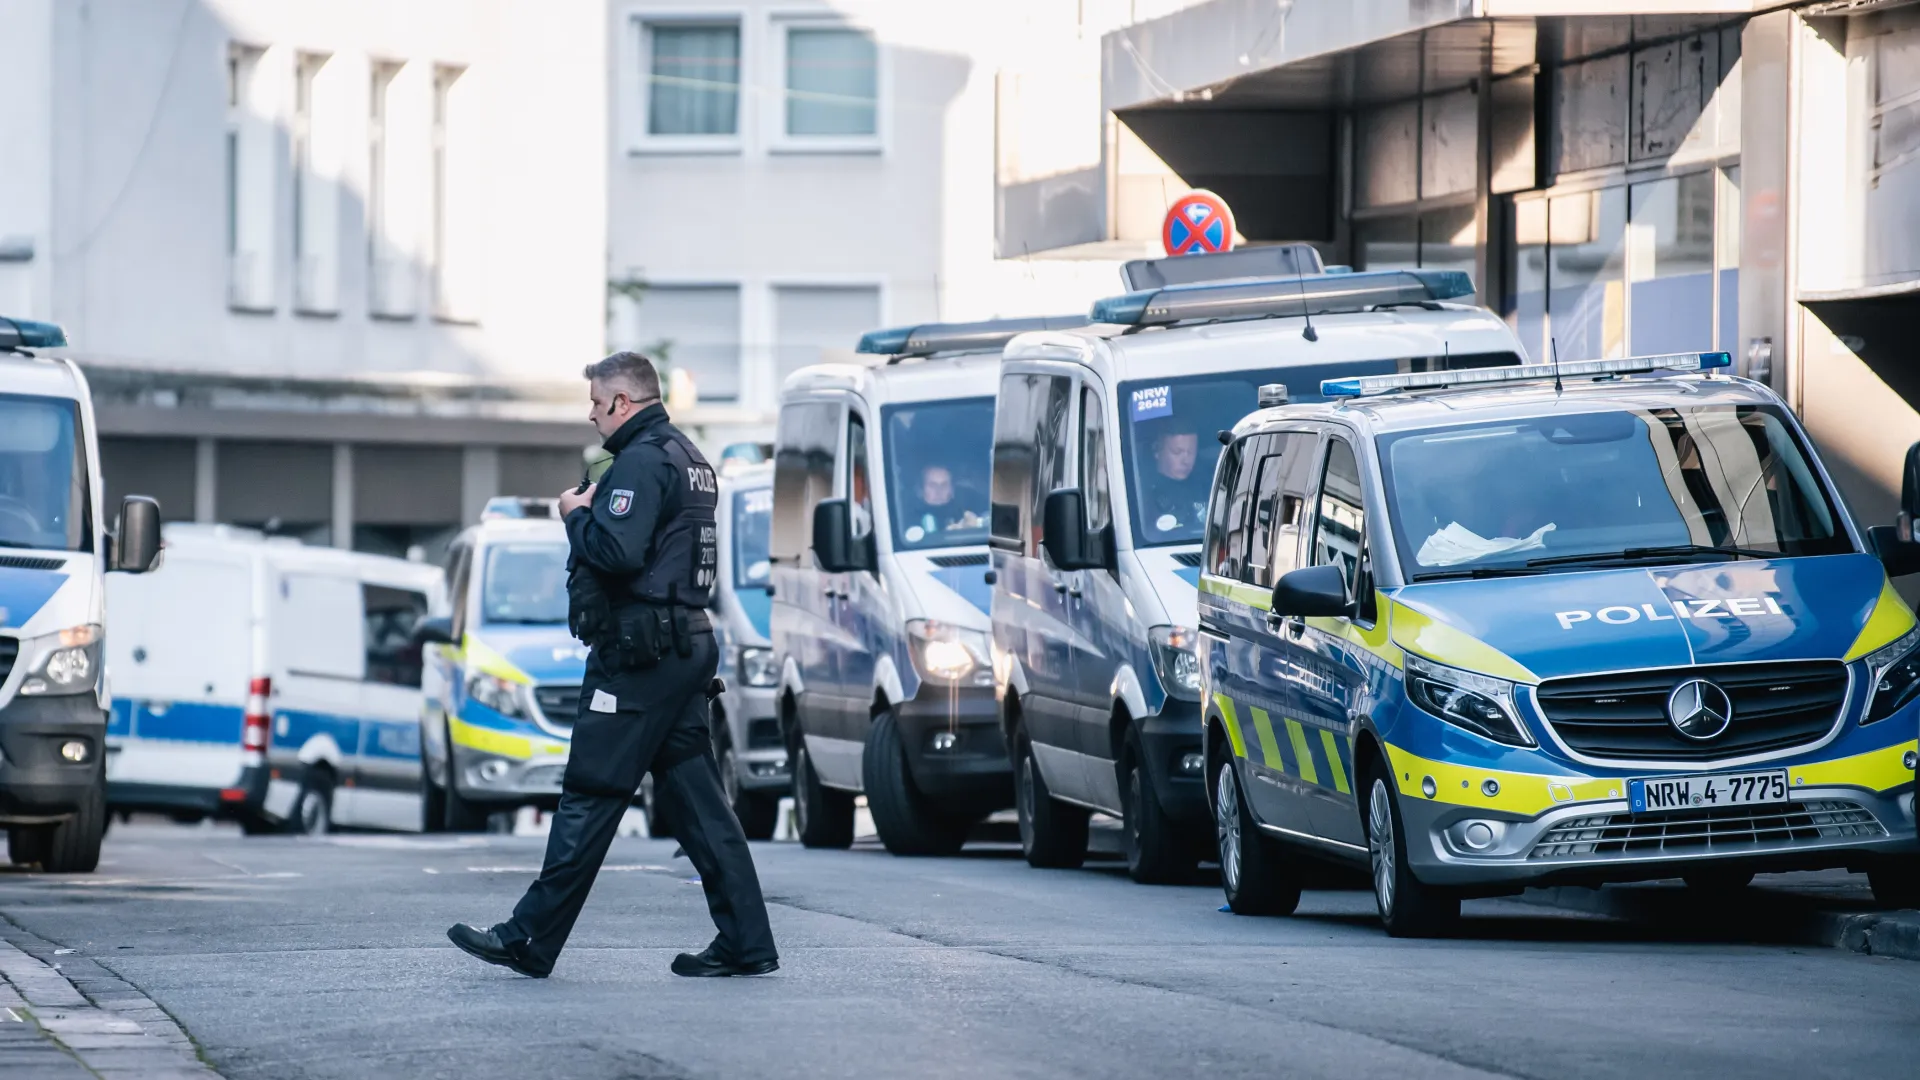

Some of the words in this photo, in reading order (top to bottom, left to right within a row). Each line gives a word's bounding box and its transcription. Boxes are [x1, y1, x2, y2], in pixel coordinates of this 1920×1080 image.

[1132, 385, 1169, 402] NRW
[1138, 397, 1167, 412] 2642
[1555, 597, 1783, 630] POLIZEI
[1635, 800, 1642, 808] D
[1645, 780, 1690, 808] NRW
[1704, 774, 1785, 803] 4-7775
